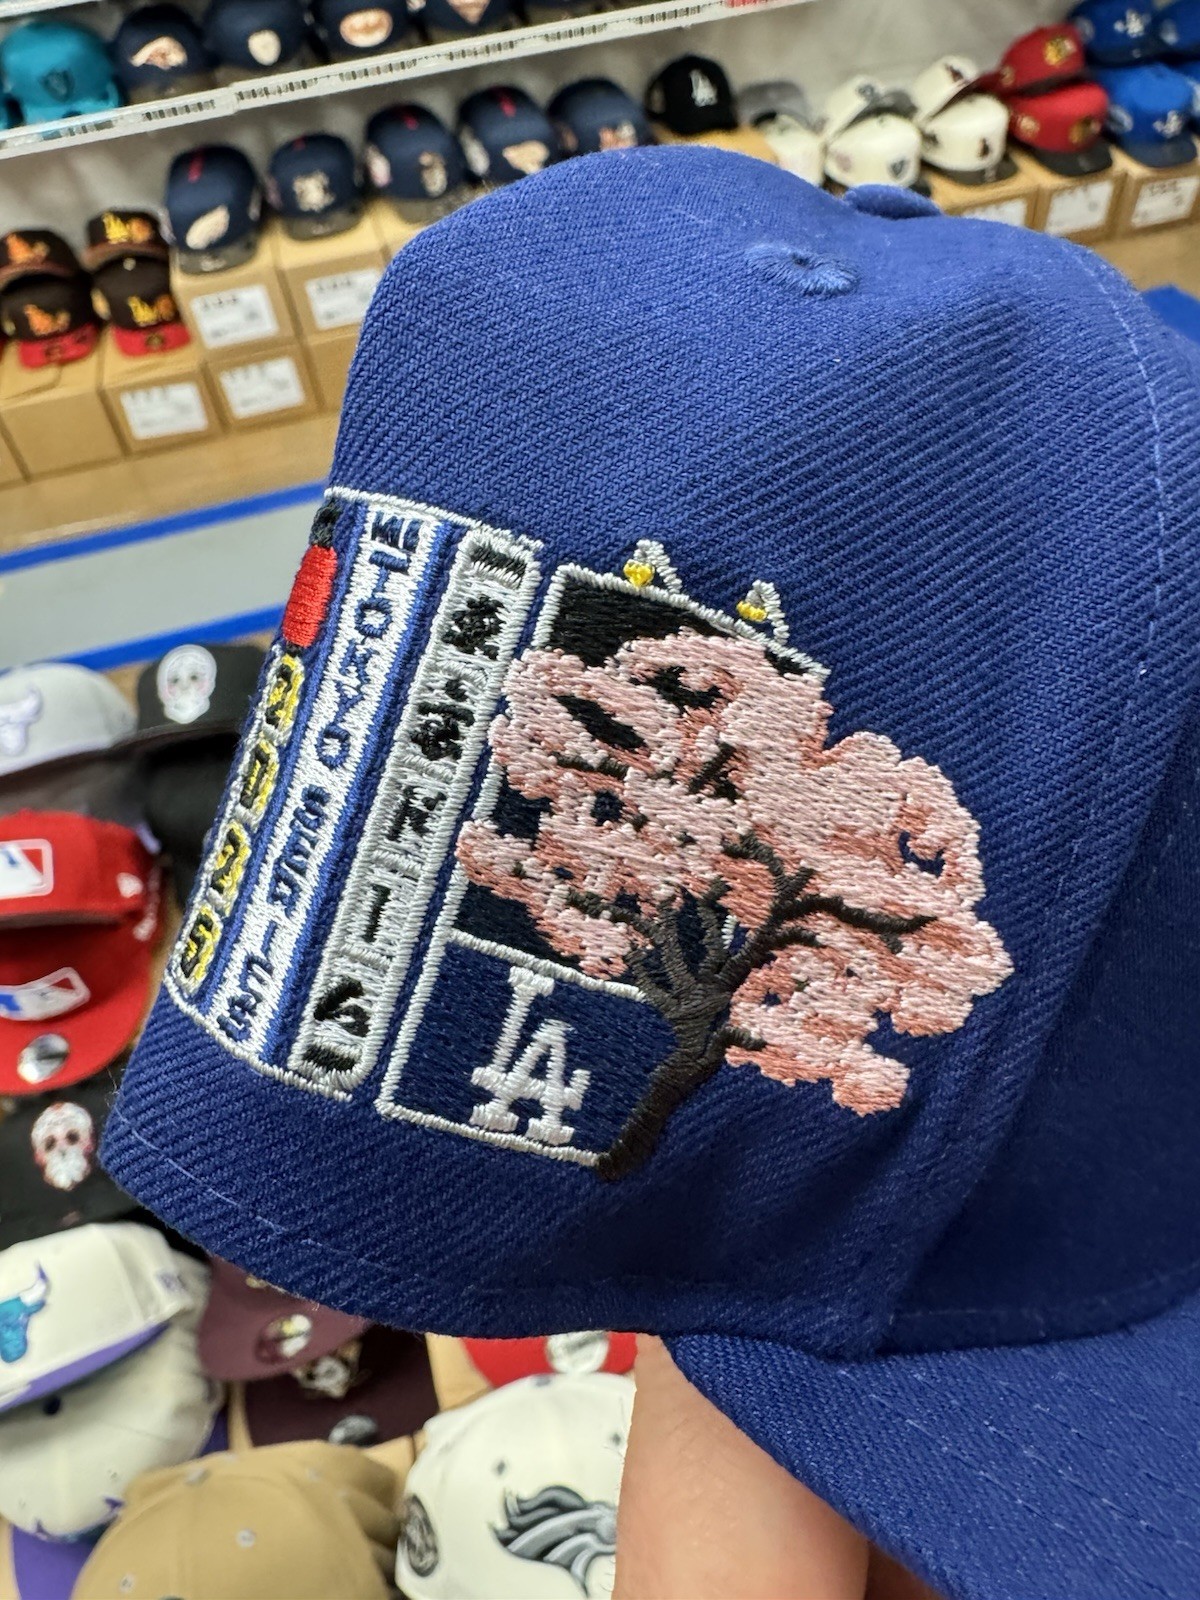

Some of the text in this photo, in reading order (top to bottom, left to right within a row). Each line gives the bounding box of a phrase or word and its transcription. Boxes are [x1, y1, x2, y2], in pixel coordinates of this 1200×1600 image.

[215, 548, 412, 1042] TOKYO SERIES
[469, 965, 592, 1147] LA
